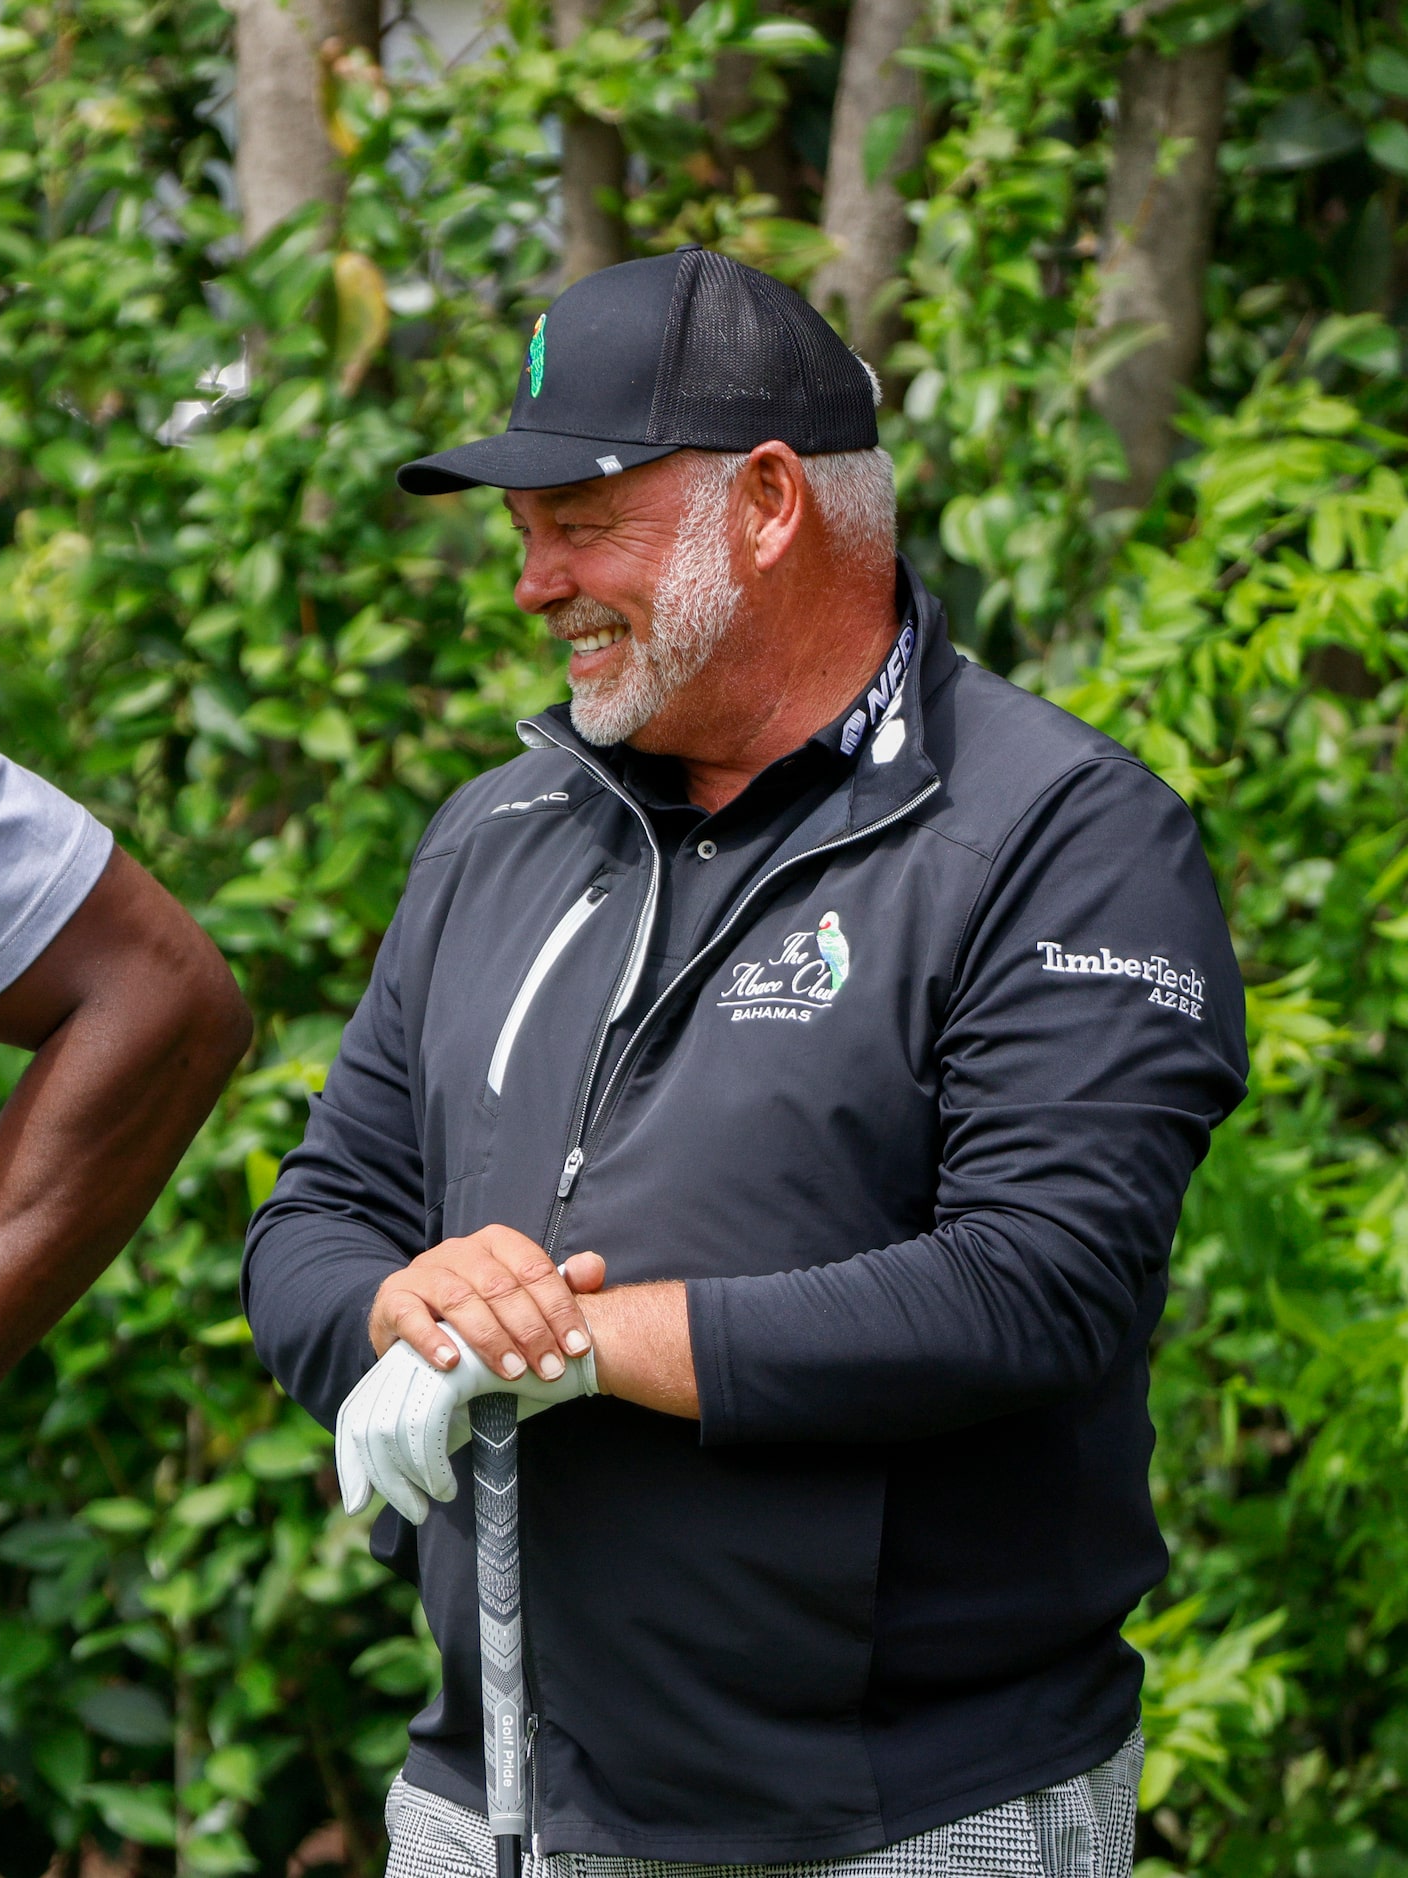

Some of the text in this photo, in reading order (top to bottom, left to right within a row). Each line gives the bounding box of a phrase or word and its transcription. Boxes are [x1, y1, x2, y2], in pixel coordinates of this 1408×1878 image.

[768, 931, 815, 965] The
[720, 961, 783, 998] Abaco
[1036, 941, 1205, 1002] TimberTech
[730, 1006, 812, 1022] BAHAMAS
[1147, 987, 1203, 1021] AZEK
[501, 1714, 514, 1788] Golf Pride
